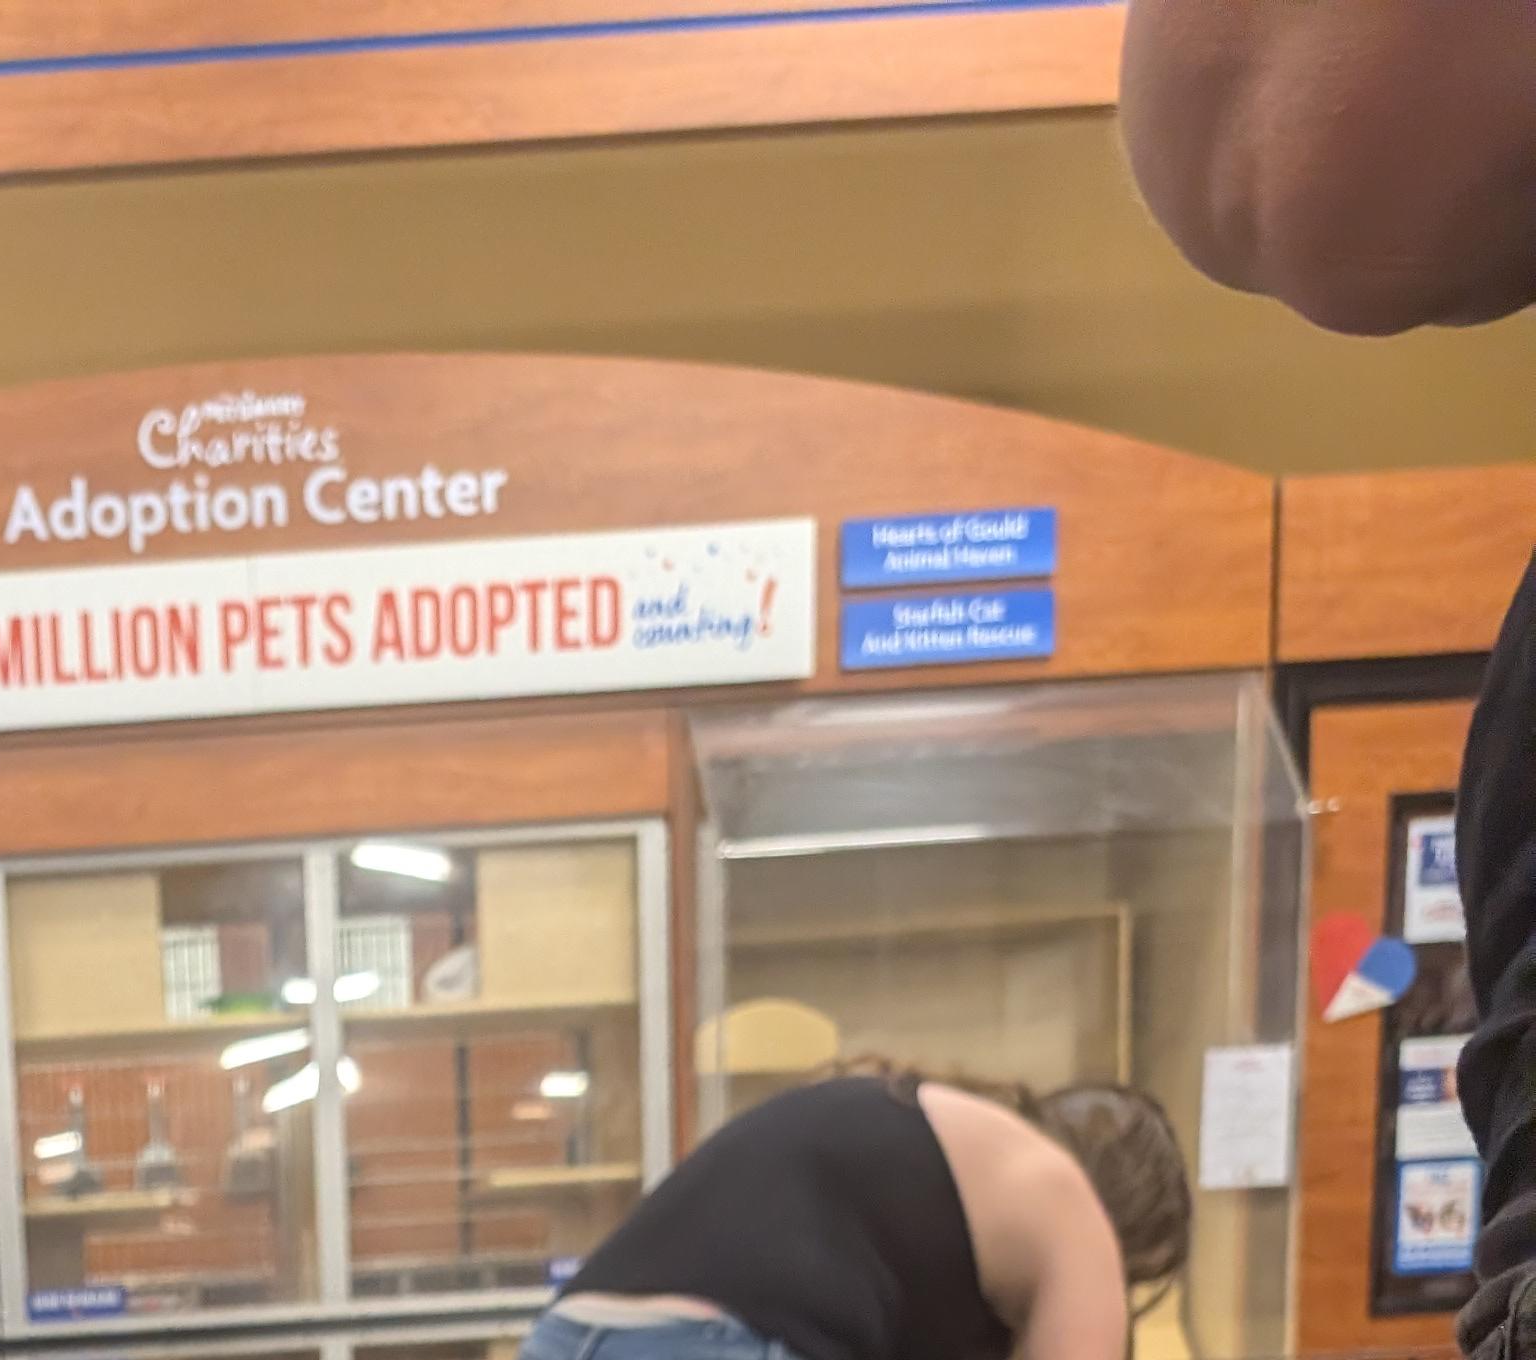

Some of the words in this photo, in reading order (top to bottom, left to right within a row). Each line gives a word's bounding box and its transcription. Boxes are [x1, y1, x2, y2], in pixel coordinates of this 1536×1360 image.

[137, 401, 340, 470] Charities
[4, 477, 287, 552] Adoption
[304, 465, 508, 525] Center
[218, 593, 354, 674] PETS
[369, 573, 623, 662] ADOPTED
